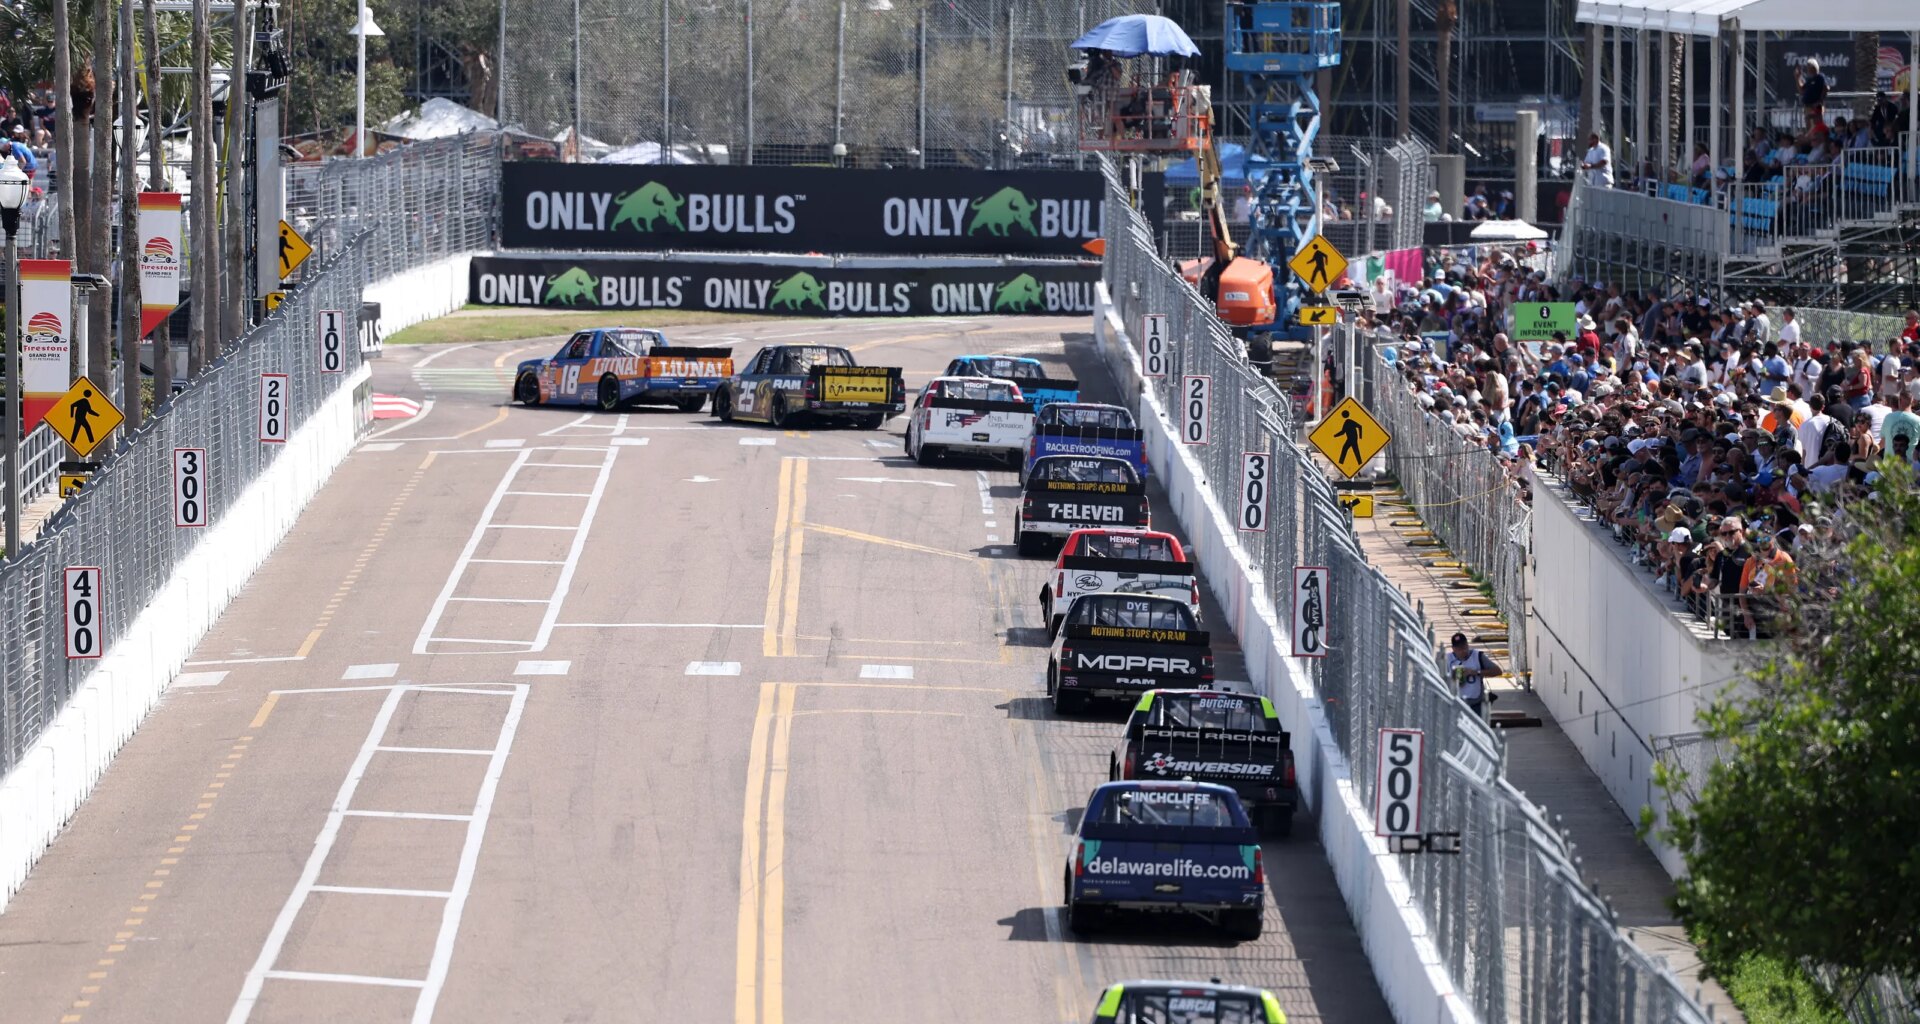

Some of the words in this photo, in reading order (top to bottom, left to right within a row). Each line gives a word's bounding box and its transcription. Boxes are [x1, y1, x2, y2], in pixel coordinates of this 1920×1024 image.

[1784, 51, 1850, 67] Trakside
[526, 191, 611, 231] ONLY
[884, 197, 969, 237] ONLY
[480, 274, 546, 305] ONLY
[704, 277, 771, 309] ONLY
[932, 282, 994, 312] ONLY
[1533, 321, 1558, 329] EVENT
[325, 313, 339, 370] 100
[803, 347, 827, 355] BRAUN
[1148, 318, 1161, 373] 100
[560, 364, 581, 395] 18
[772, 379, 801, 389] RAM
[267, 380, 279, 435] 200
[738, 381, 758, 412] 25
[1074, 409, 1099, 417] SUTTON
[1189, 379, 1203, 441] 200
[1046, 442, 1131, 456] RACKLEYROOFING.com
[182, 451, 198, 523] 300
[1048, 481, 1075, 490] NOTHING
[1076, 482, 1097, 491] STOPS
[1111, 484, 1127, 492] RAM
[1245, 455, 1264, 529] 300
[1110, 535, 1139, 544] HEMRIC
[73, 570, 93, 654] 400
[1127, 601, 1149, 611] DYE
[1312, 586, 1320, 625] MYLAPS
[1091, 626, 1125, 637] NOTHING
[1126, 628, 1150, 639] STOPS
[1168, 631, 1185, 641] RAM
[1116, 677, 1156, 685] RAM
[1200, 698, 1243, 709] BUTCHER
[1143, 729, 1200, 738] FORD
[1205, 733, 1281, 743] RACING
[1173, 761, 1274, 775] RIVERSIDE
[1386, 733, 1413, 832] 500
[1088, 856, 1249, 879] delawarelife.com
[1242, 893, 1257, 903] 77
[1169, 997, 1216, 1012] GARCIA
